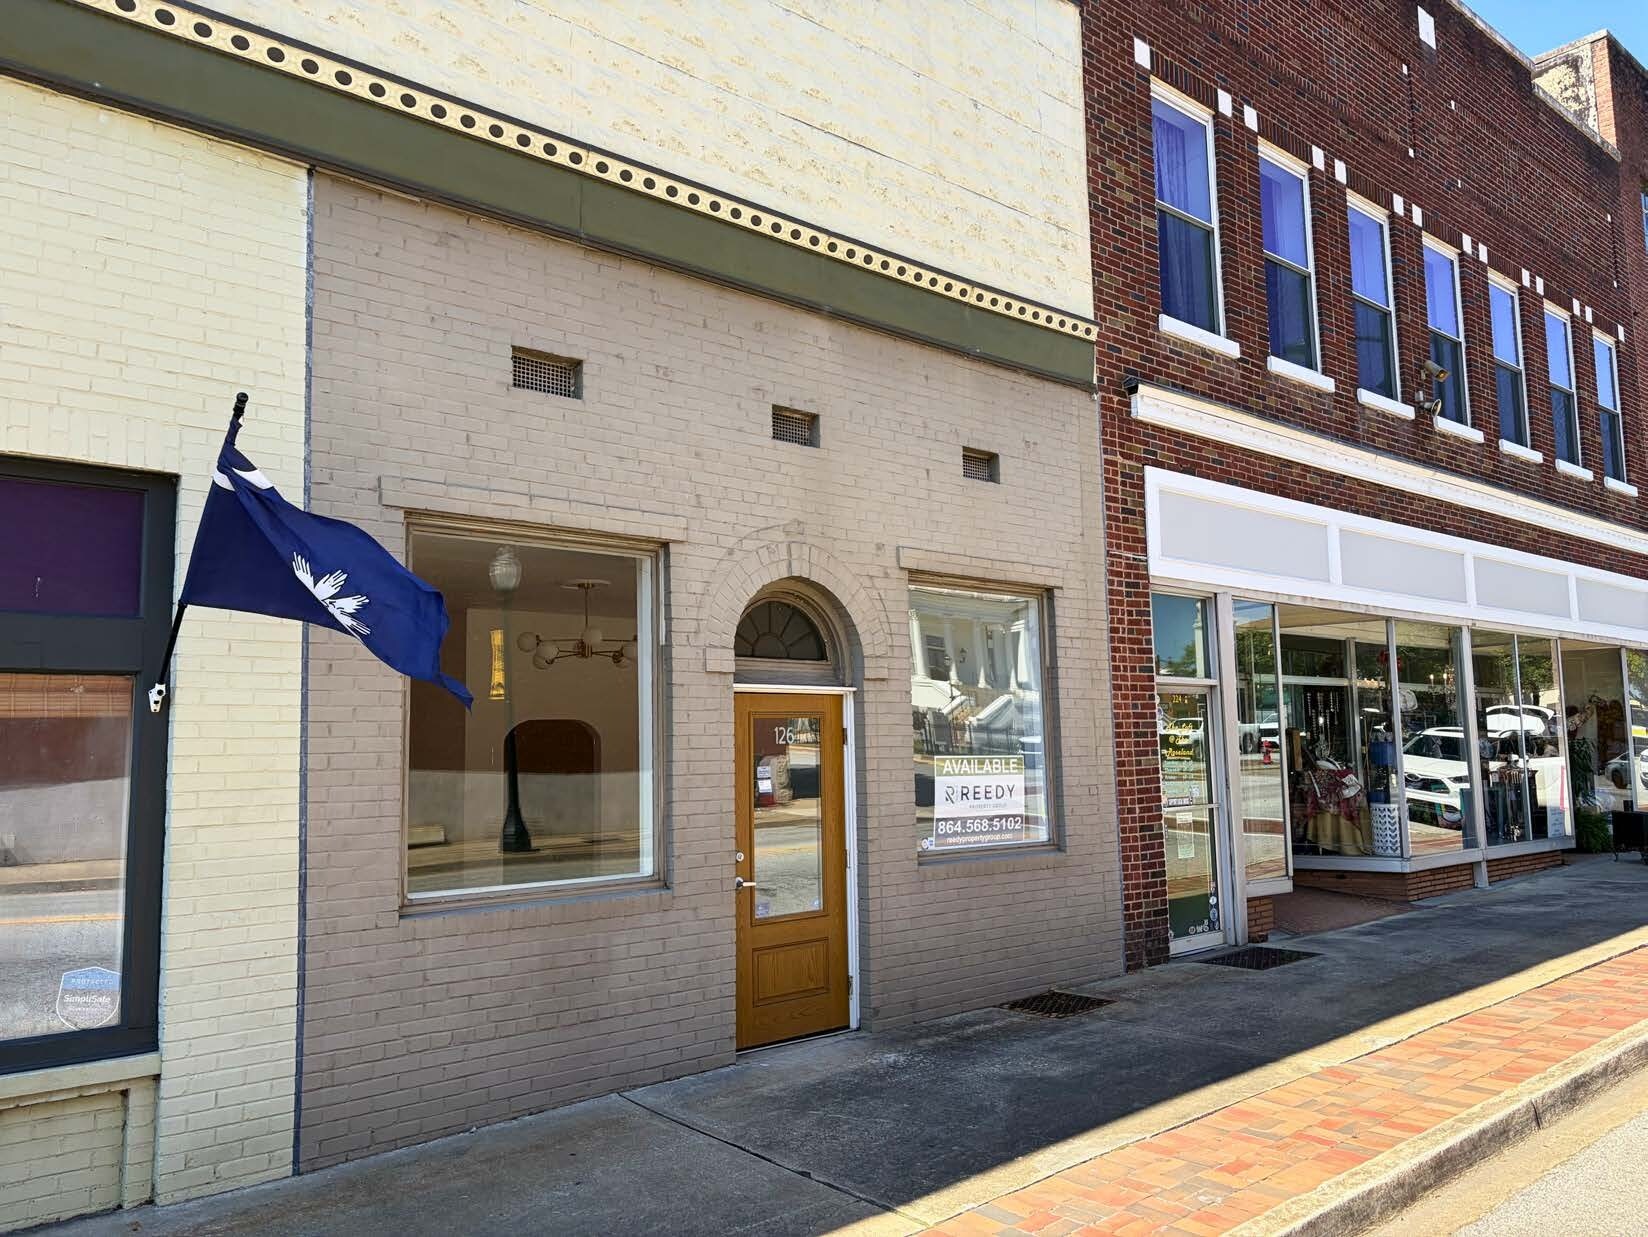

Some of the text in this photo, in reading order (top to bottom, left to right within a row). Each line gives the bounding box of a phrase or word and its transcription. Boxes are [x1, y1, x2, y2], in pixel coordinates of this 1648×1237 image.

[774, 726, 795, 744] 126
[943, 759, 1018, 774] AVAILABLE
[960, 784, 1015, 800] REEDY
[938, 817, 1022, 834] 864.568.5102
[64, 994, 111, 1004] SimpliSafe
